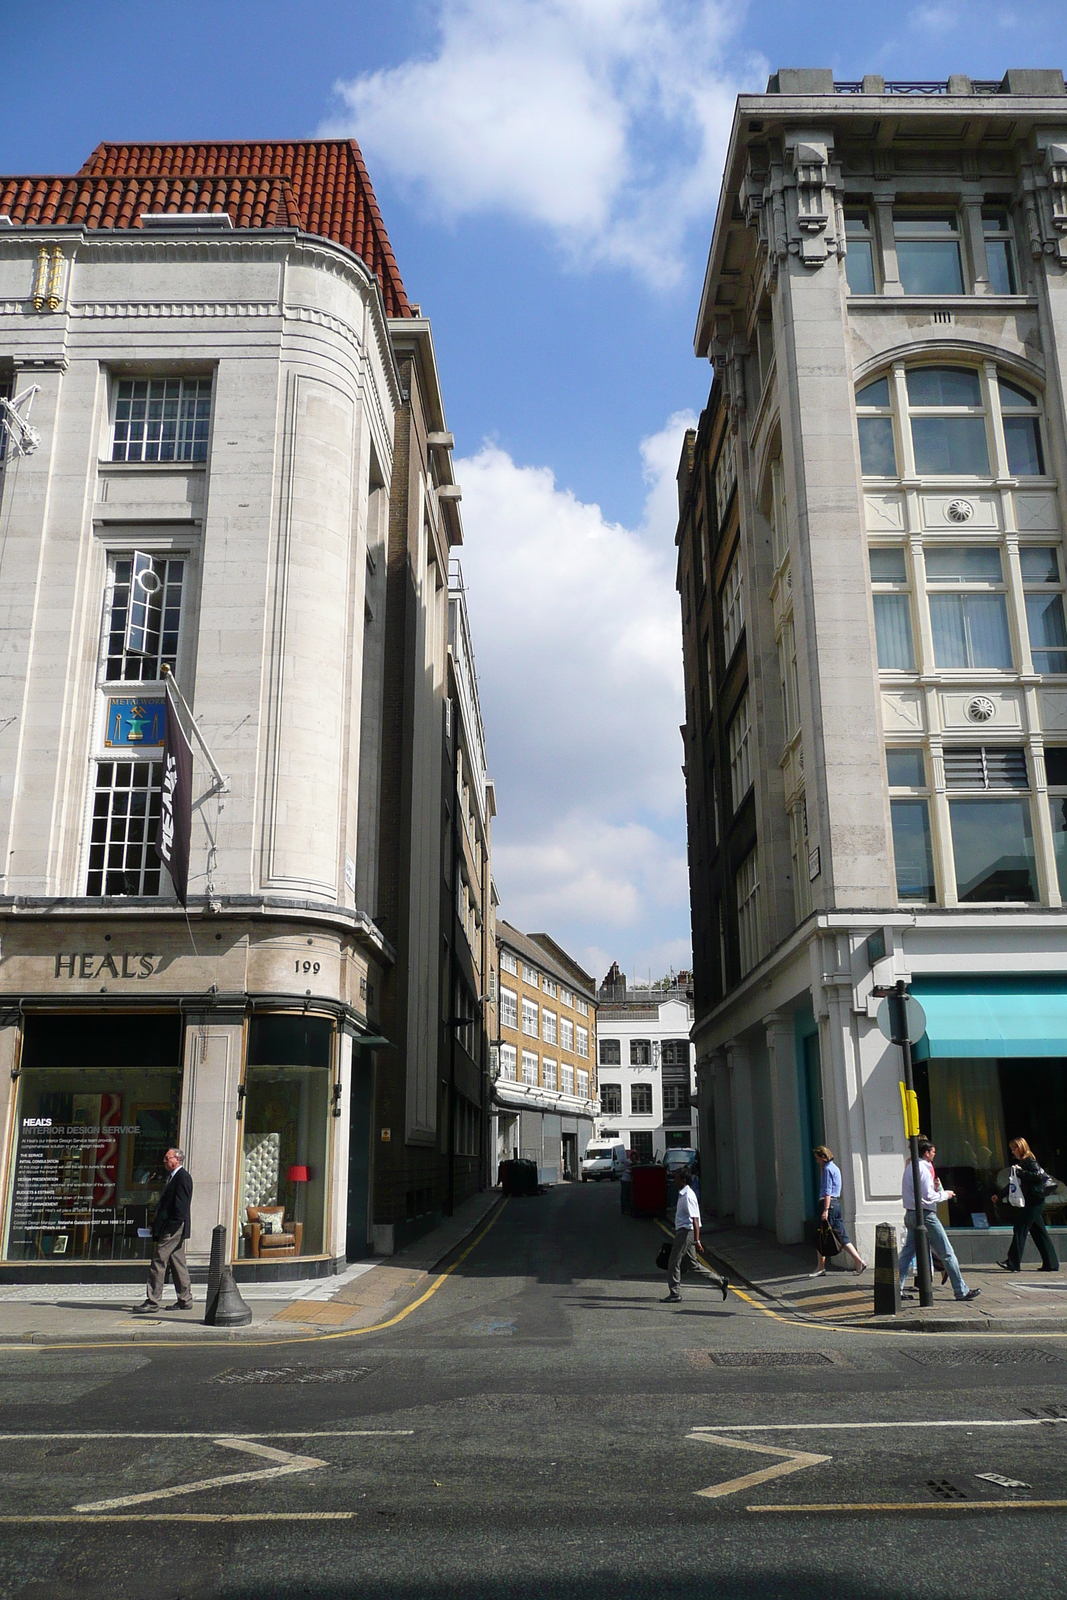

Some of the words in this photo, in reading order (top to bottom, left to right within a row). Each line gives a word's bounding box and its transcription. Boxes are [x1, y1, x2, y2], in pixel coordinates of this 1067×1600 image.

[111, 698, 166, 706] METALWORK
[54, 951, 155, 979] HEAL'S
[295, 959, 320, 974] 199
[23, 1126, 65, 1135] INTERIOR
[66, 1126, 100, 1135] DESIGN
[102, 1126, 141, 1135] SERVICE
